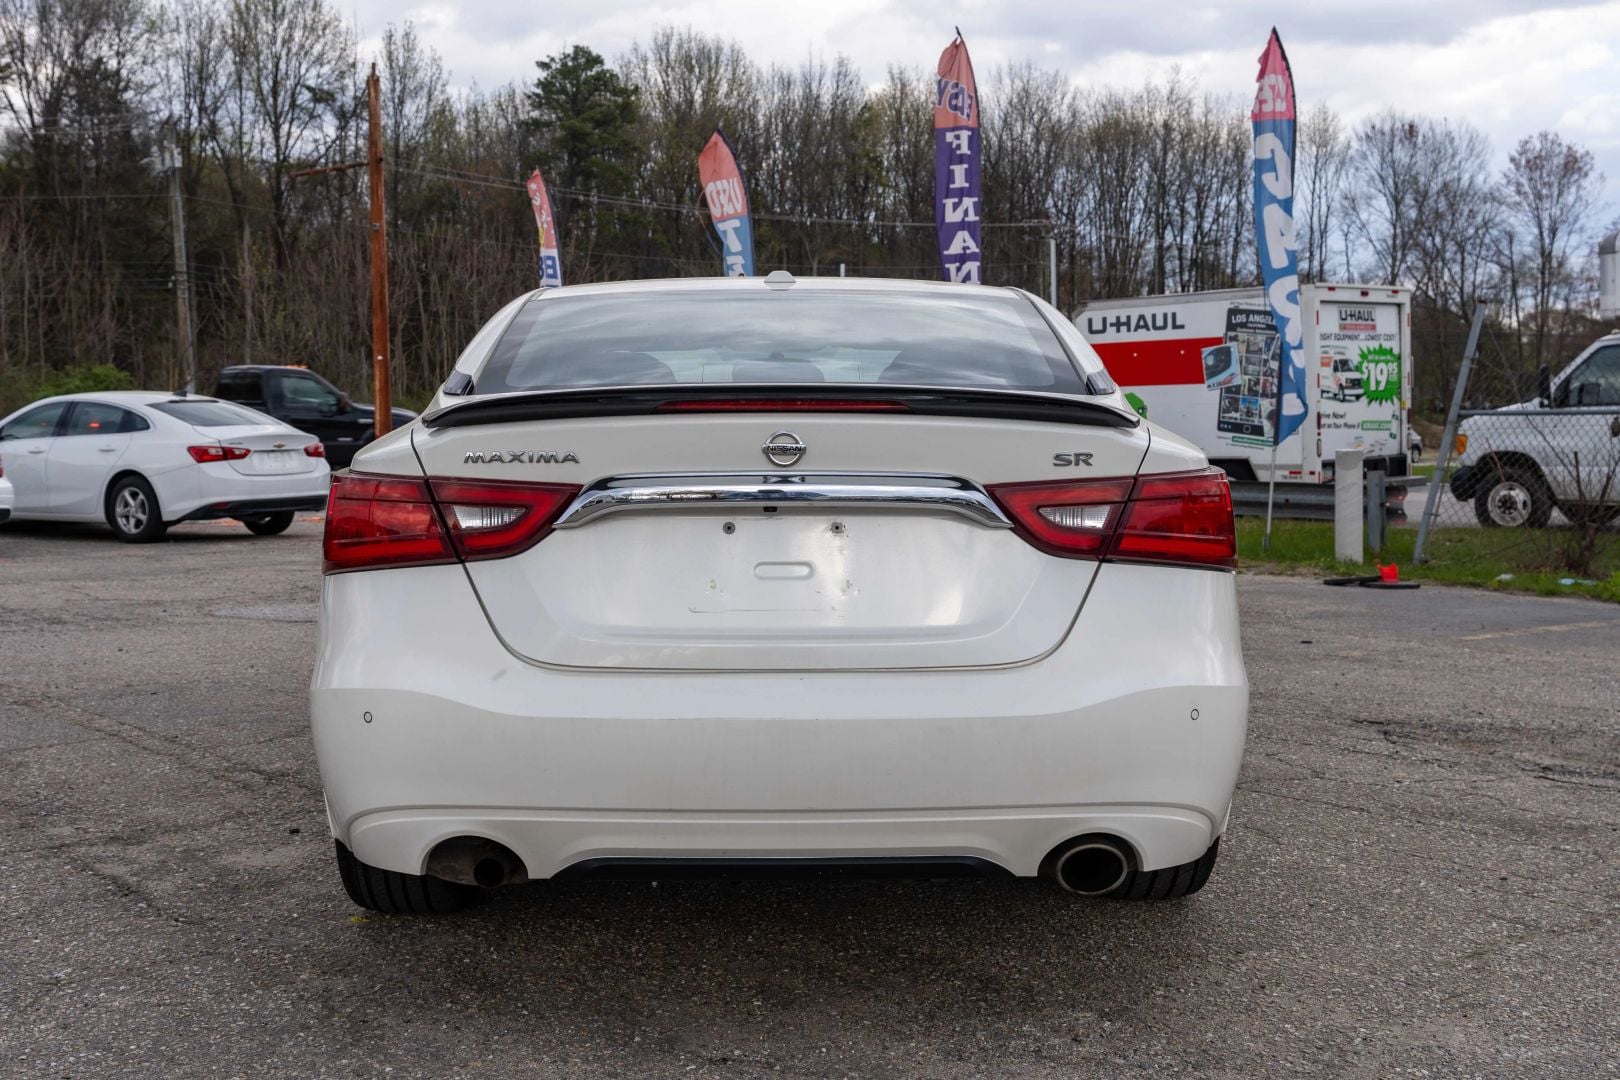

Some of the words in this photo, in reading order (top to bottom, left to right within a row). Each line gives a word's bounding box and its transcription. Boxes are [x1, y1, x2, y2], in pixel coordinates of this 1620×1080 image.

[1231, 315, 1247, 324] LOS
[1339, 309, 1376, 322] U-HAUL
[1087, 311, 1185, 335] U-HAUL
[463, 451, 580, 463] MAXIMA
[1053, 451, 1094, 467] SR
